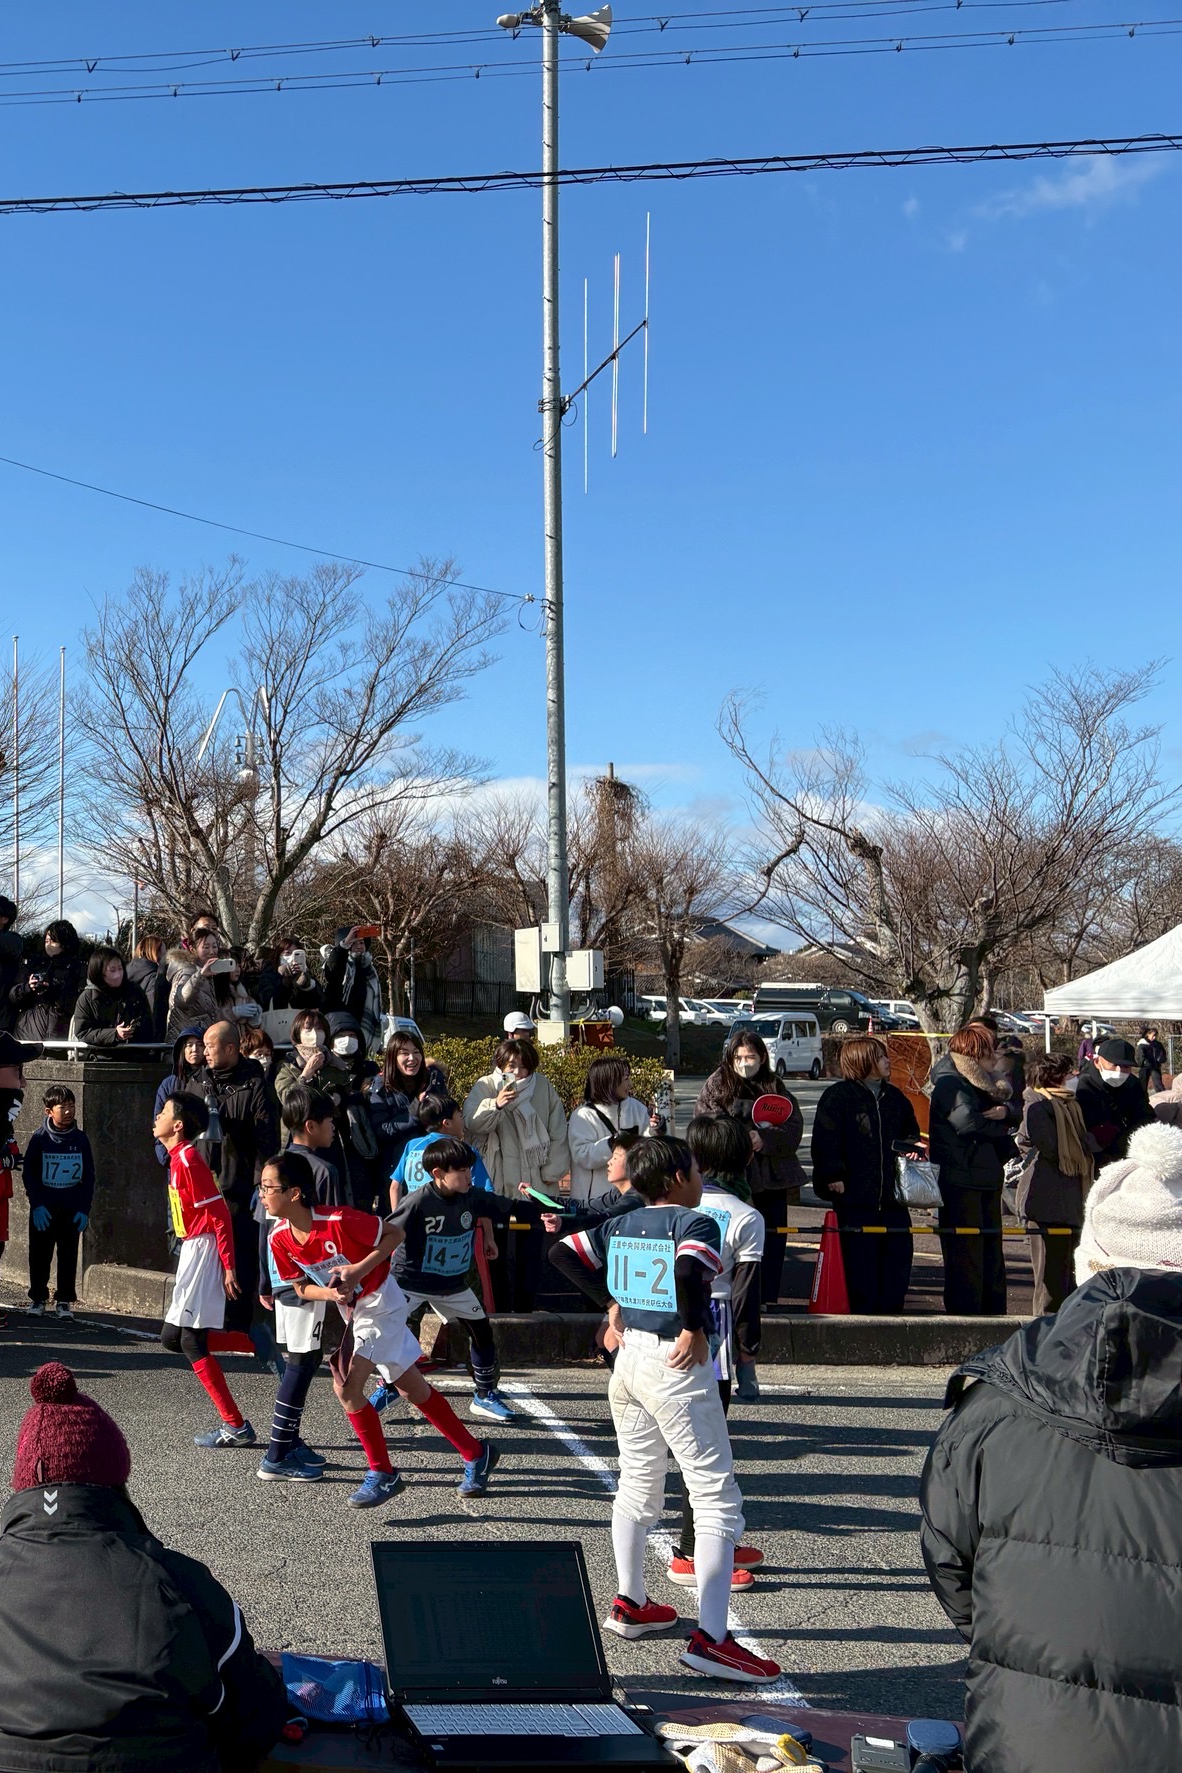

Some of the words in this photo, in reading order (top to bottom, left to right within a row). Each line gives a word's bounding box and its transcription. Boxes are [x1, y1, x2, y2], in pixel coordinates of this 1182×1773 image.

[45, 1161, 82, 1181] 17-2
[408, 1160, 425, 1182] 18
[424, 1215, 446, 1235] 27
[426, 1241, 470, 1267] 14-2
[614, 1254, 669, 1296] 11-2
[312, 1319, 322, 1342] 4
